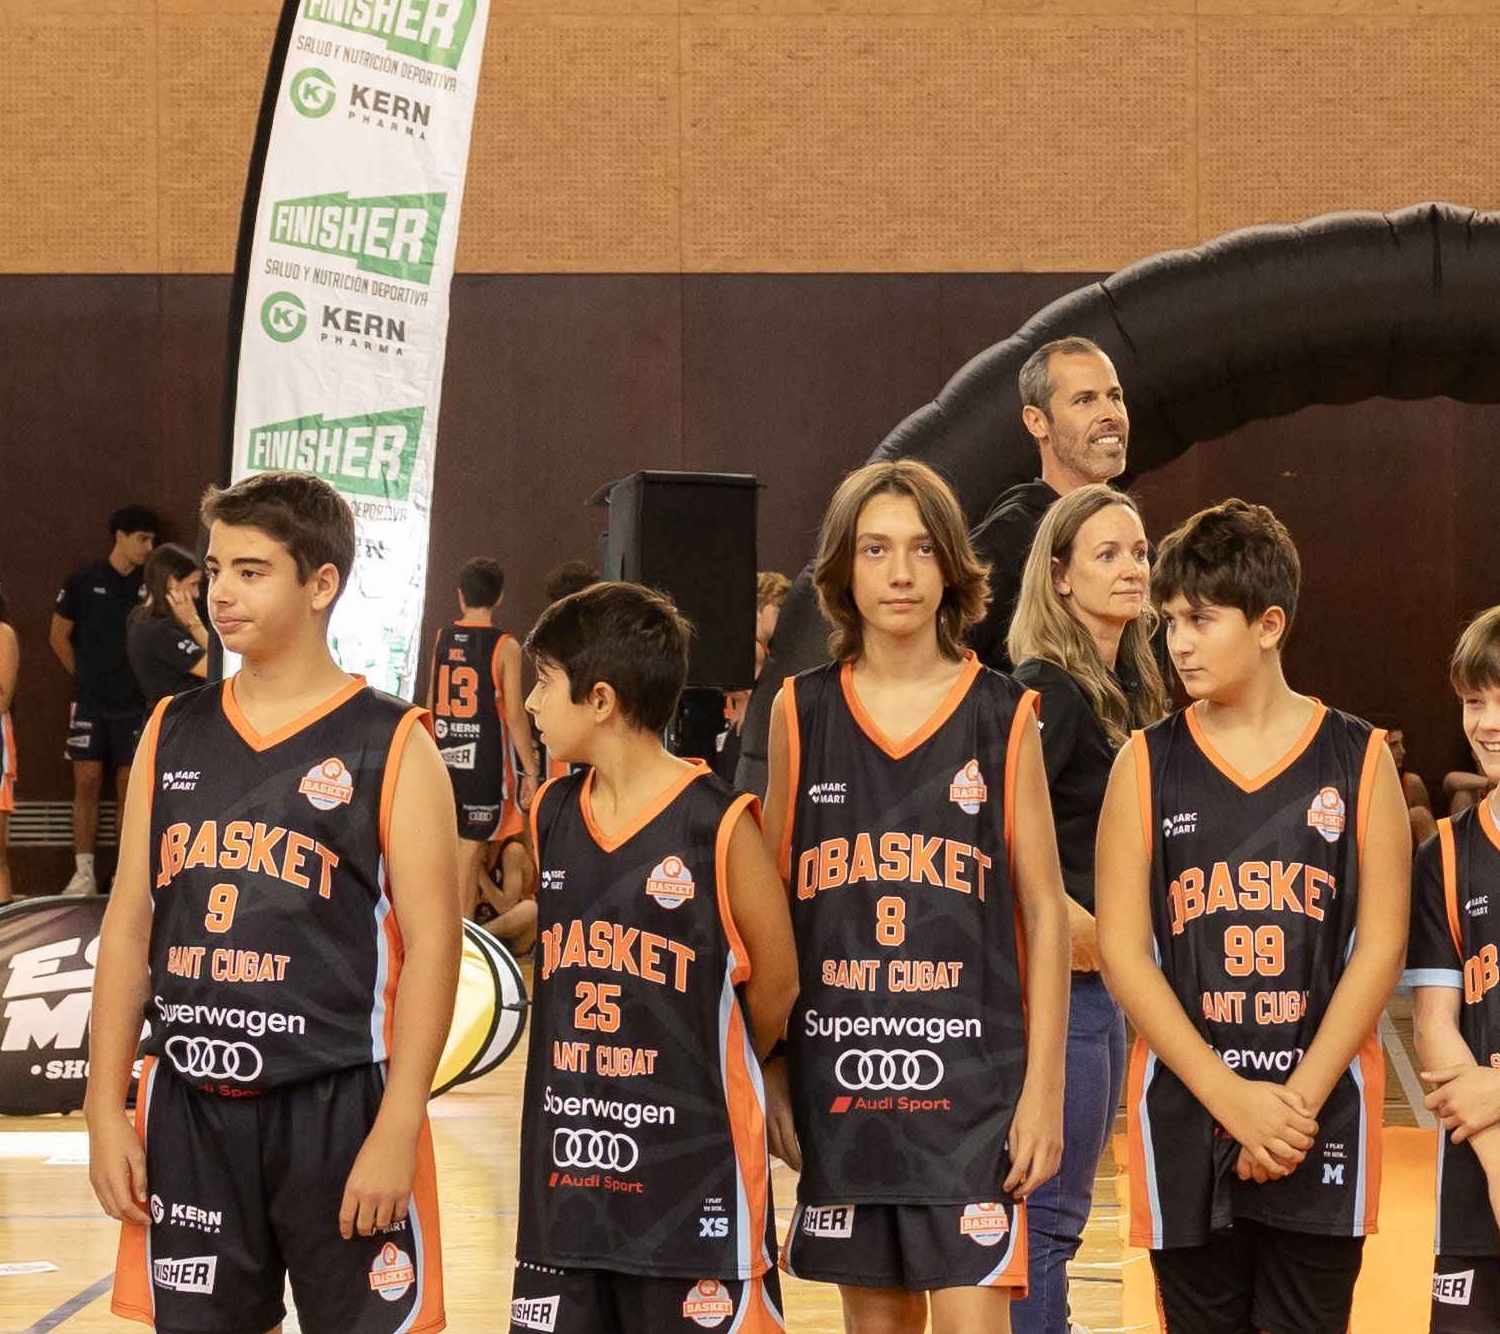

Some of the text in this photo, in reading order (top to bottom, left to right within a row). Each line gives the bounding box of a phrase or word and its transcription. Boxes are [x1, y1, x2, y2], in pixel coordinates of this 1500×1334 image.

[296, 35, 457, 92] SALUD Y NUTRICIÓN DEPORTIVA
[350, 84, 431, 127] KERN
[348, 110, 426, 140] PHARMA
[275, 205, 427, 264] FINISHER
[264, 259, 428, 306] SALUD Y NUTRICIÓN DEPORTIVA
[322, 305, 406, 342] KERN
[321, 333, 404, 356] PHARMA
[254, 425, 408, 481] FINISHER
[435, 664, 479, 719] 13
[303, 780, 350, 799] BASKET
[820, 782, 847, 792] MARC
[820, 794, 845, 804] MART
[797, 832, 992, 902] QBASKET
[649, 881, 692, 895] BASKET
[1168, 861, 1337, 935] QBASKE
[204, 883, 239, 934] 9
[876, 896, 906, 946] 8
[167, 946, 291, 983] SANT CUGAT
[541, 919, 696, 993] BASKET
[1224, 925, 1285, 977] 99
[822, 960, 963, 992] SANT CUGAT
[574, 981, 621, 1033] 25
[1202, 991, 1246, 1024] ANT
[805, 1009, 982, 1043] Superwagen
[554, 1041, 658, 1077] ANT CUGAT
[854, 1096, 951, 1112] Audi Sport
[561, 1174, 644, 1193] Audi Sport
[1322, 1163, 1344, 1185] M
[170, 1219, 221, 1234] PHARMA
[171, 1203, 223, 1225] KERN
[699, 1217, 729, 1237] XS
[686, 1301, 730, 1314] BASKET
